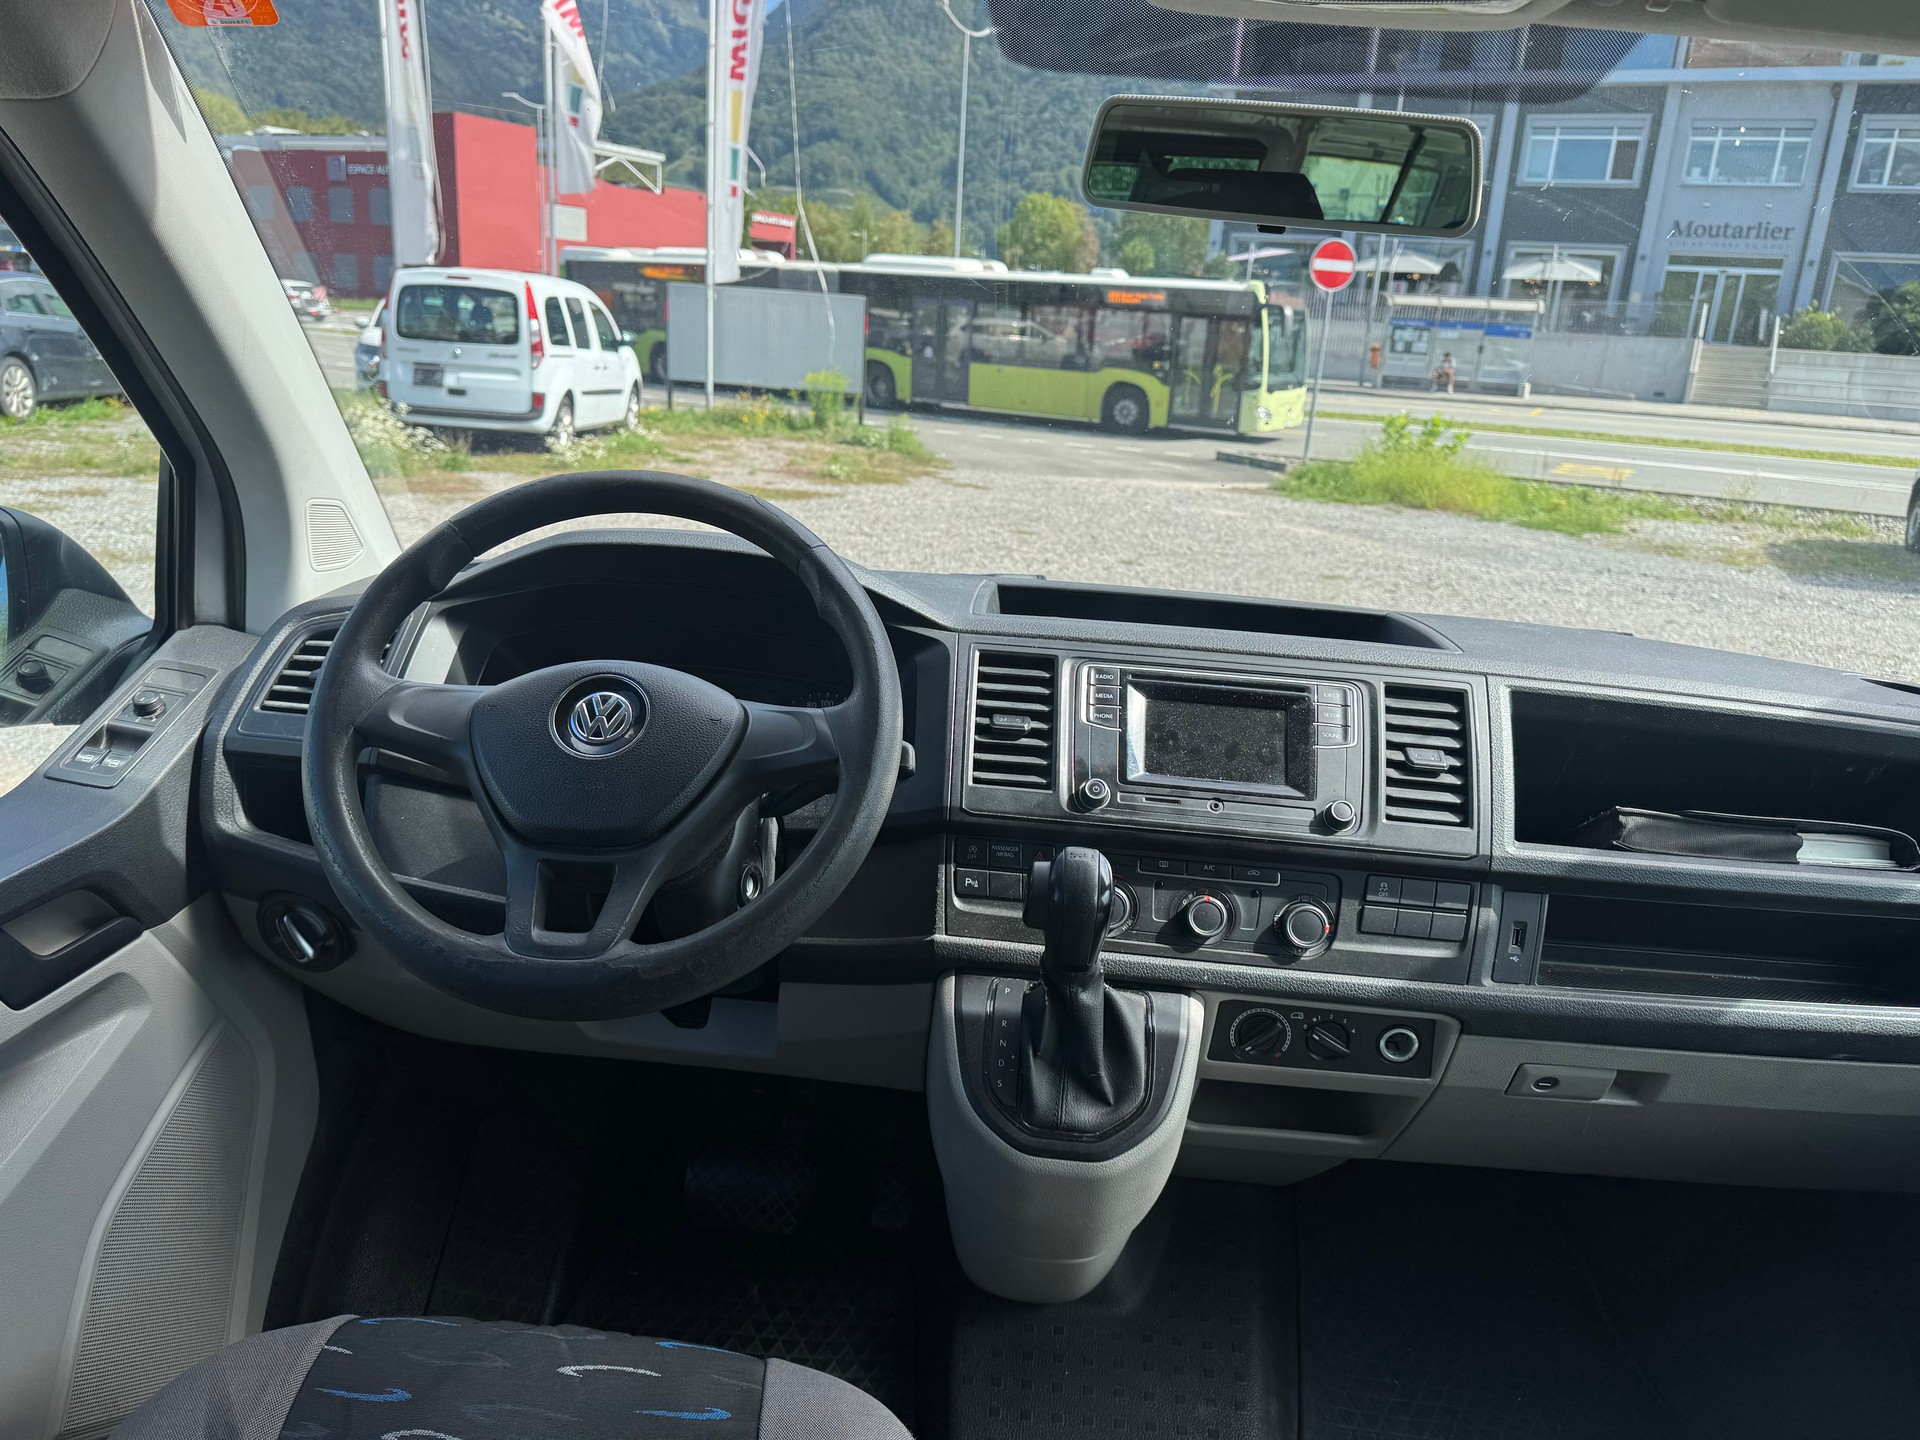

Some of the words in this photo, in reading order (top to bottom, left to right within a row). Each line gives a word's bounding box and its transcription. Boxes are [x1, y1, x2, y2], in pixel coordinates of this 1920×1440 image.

[1671, 219, 1796, 241] Moutarlier
[1093, 712, 1114, 720] PHONE
[1322, 731, 1343, 739] SOUND
[991, 844, 1020, 852] PASSENGER
[995, 851, 1015, 859] AIRBAG
[1001, 1020, 1008, 1028] R
[999, 1039, 1007, 1047] N
[998, 1059, 1005, 1067] D
[997, 1079, 1003, 1088] S
